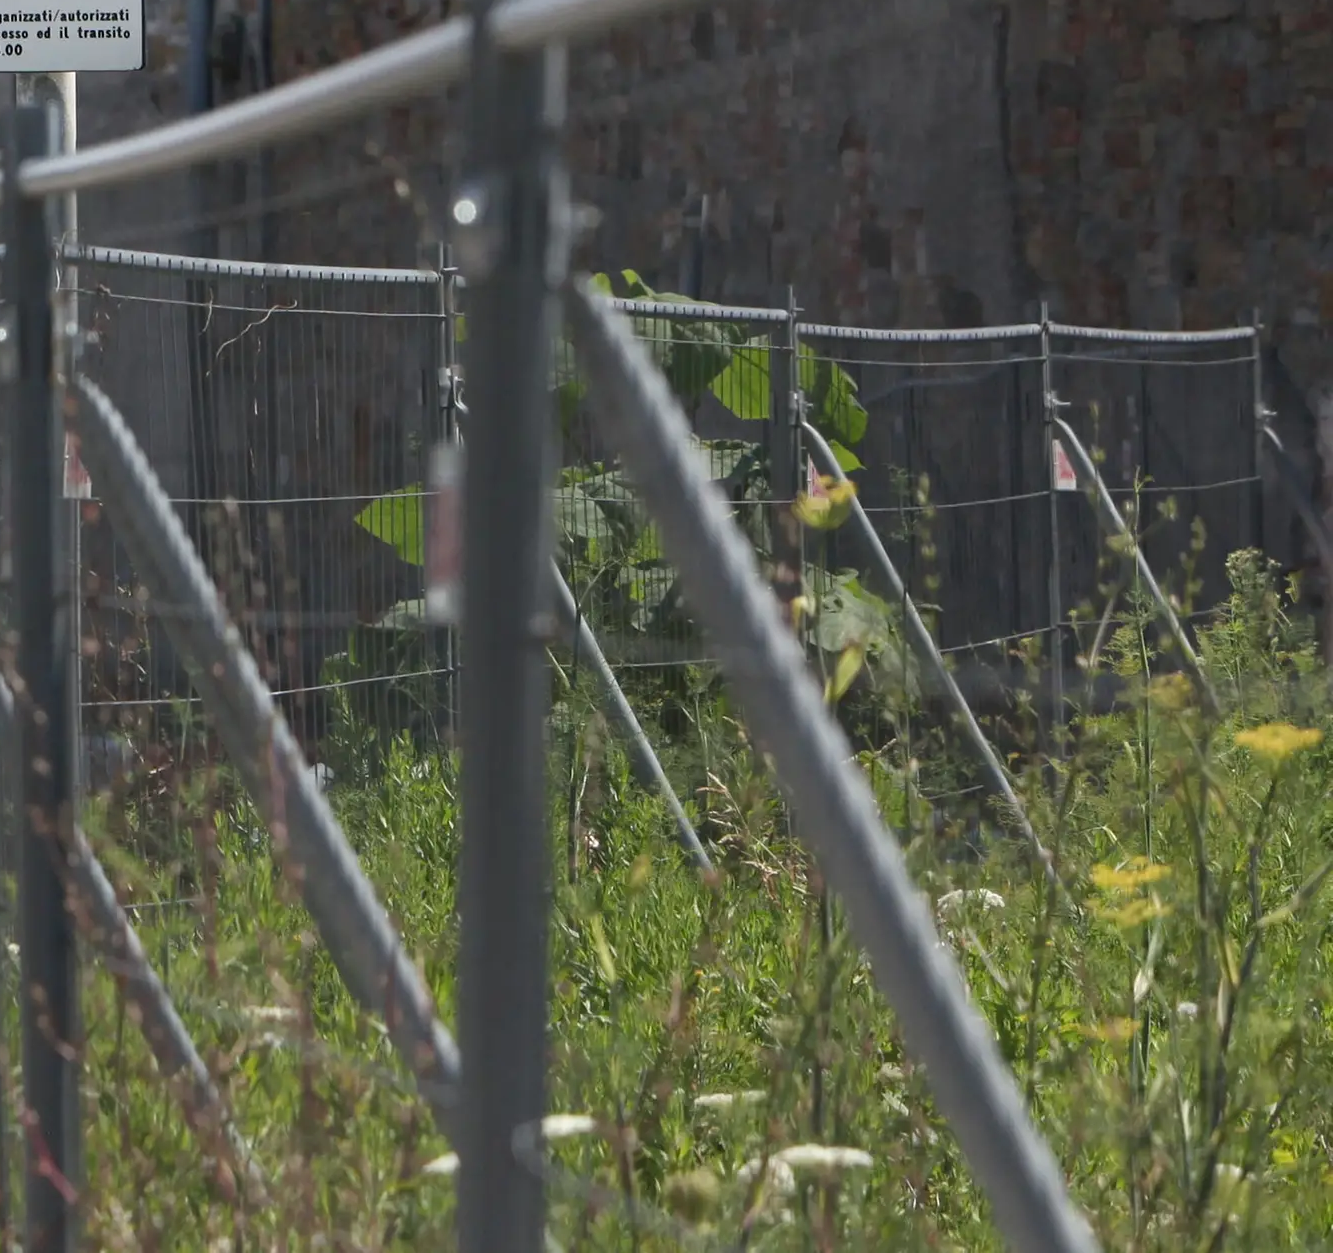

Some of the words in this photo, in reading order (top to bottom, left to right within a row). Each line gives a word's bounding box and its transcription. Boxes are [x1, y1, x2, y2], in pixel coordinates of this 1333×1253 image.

[36, 26, 51, 39] ed
[59, 26, 70, 39] il
[77, 25, 131, 39] transito
